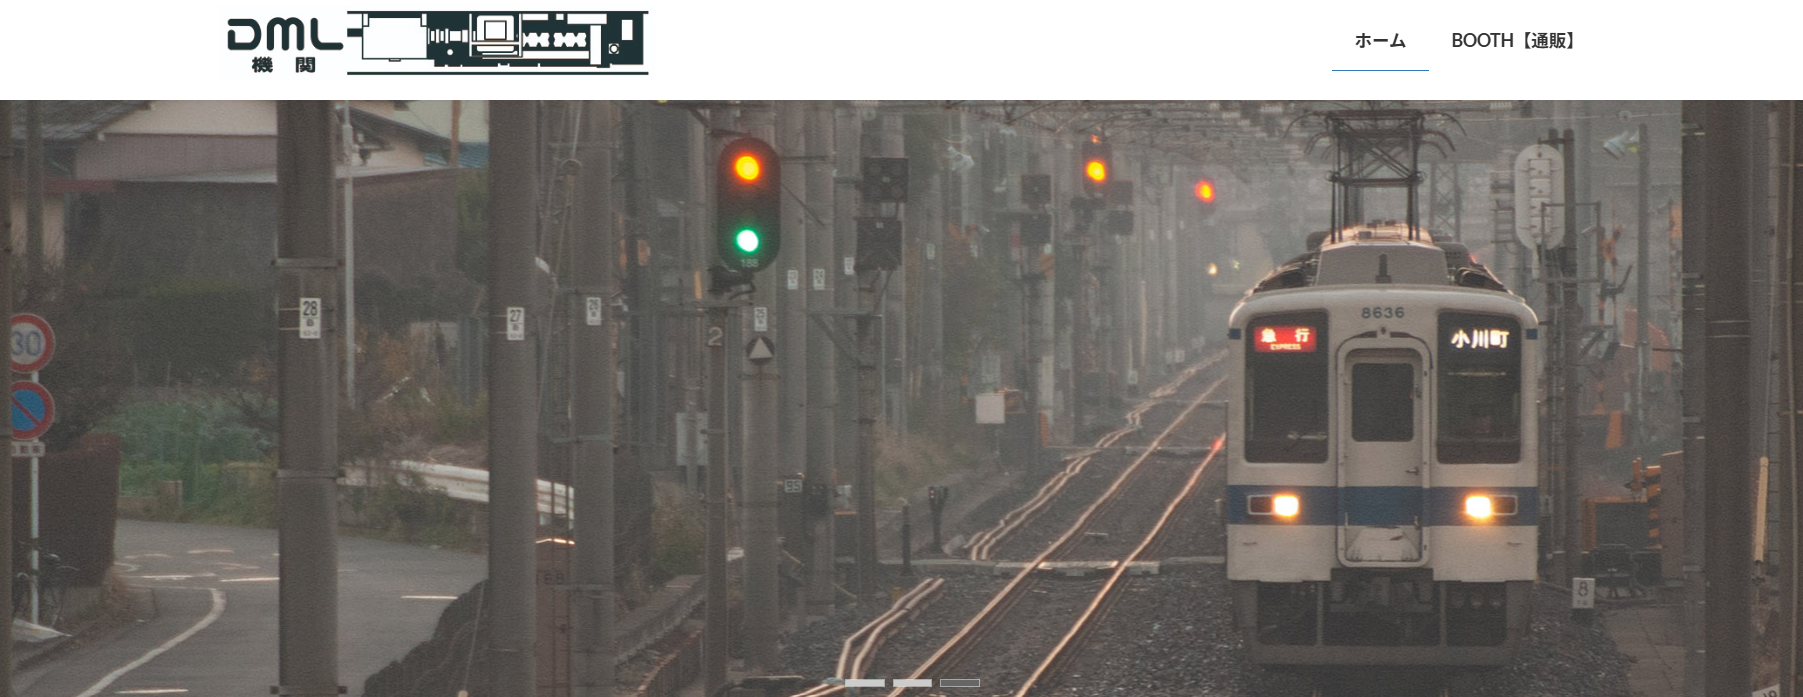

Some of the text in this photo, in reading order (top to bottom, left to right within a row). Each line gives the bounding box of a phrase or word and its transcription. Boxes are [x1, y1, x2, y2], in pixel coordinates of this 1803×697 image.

[302, 300, 318, 317] 28
[510, 309, 522, 322] 27
[1361, 306, 1405, 319] 8636
[12, 330, 41, 356] 30
[707, 326, 724, 347] 2
[1261, 328, 1310, 342] 急行
[1451, 328, 1510, 349] 小川町
[1577, 581, 1589, 597] 8
